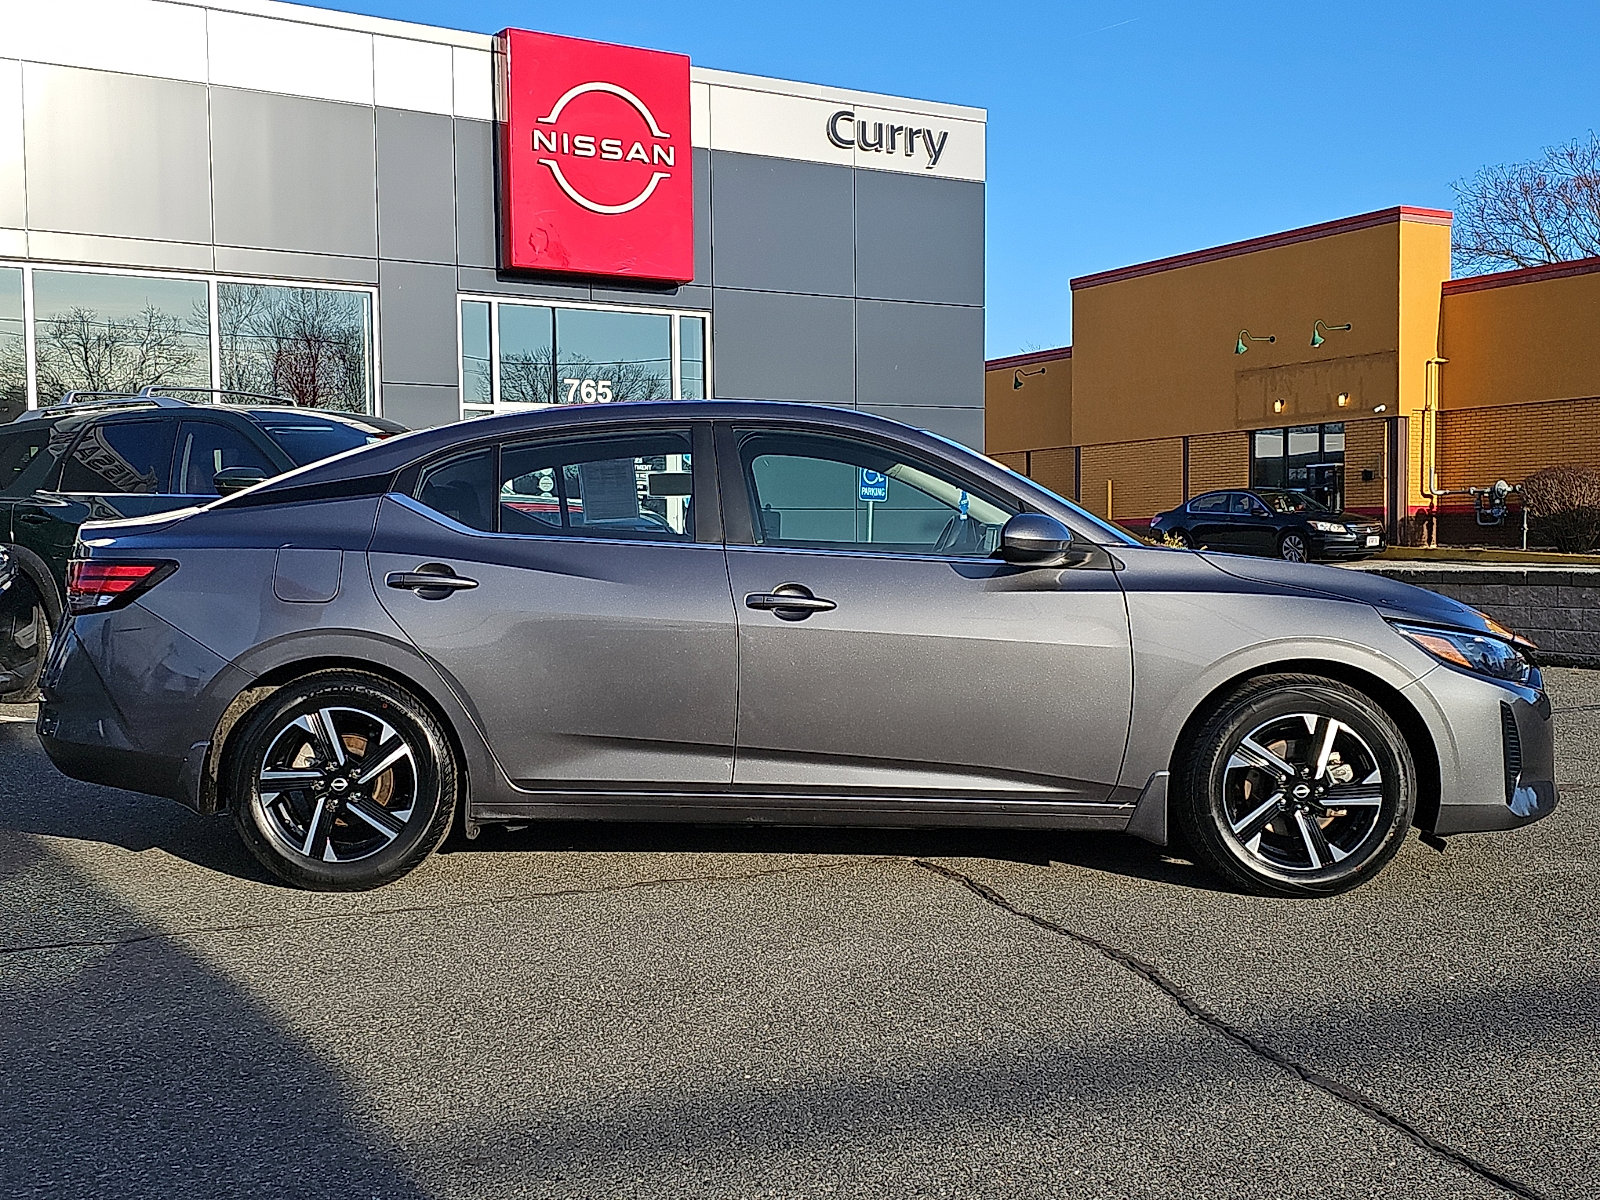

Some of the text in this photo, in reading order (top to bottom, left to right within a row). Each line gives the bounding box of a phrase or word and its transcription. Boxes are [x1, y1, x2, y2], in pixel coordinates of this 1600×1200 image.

[532, 129, 675, 167] NISSAN
[826, 110, 949, 169] Curry
[563, 378, 613, 404] 765
[861, 486, 886, 497] PARKING
